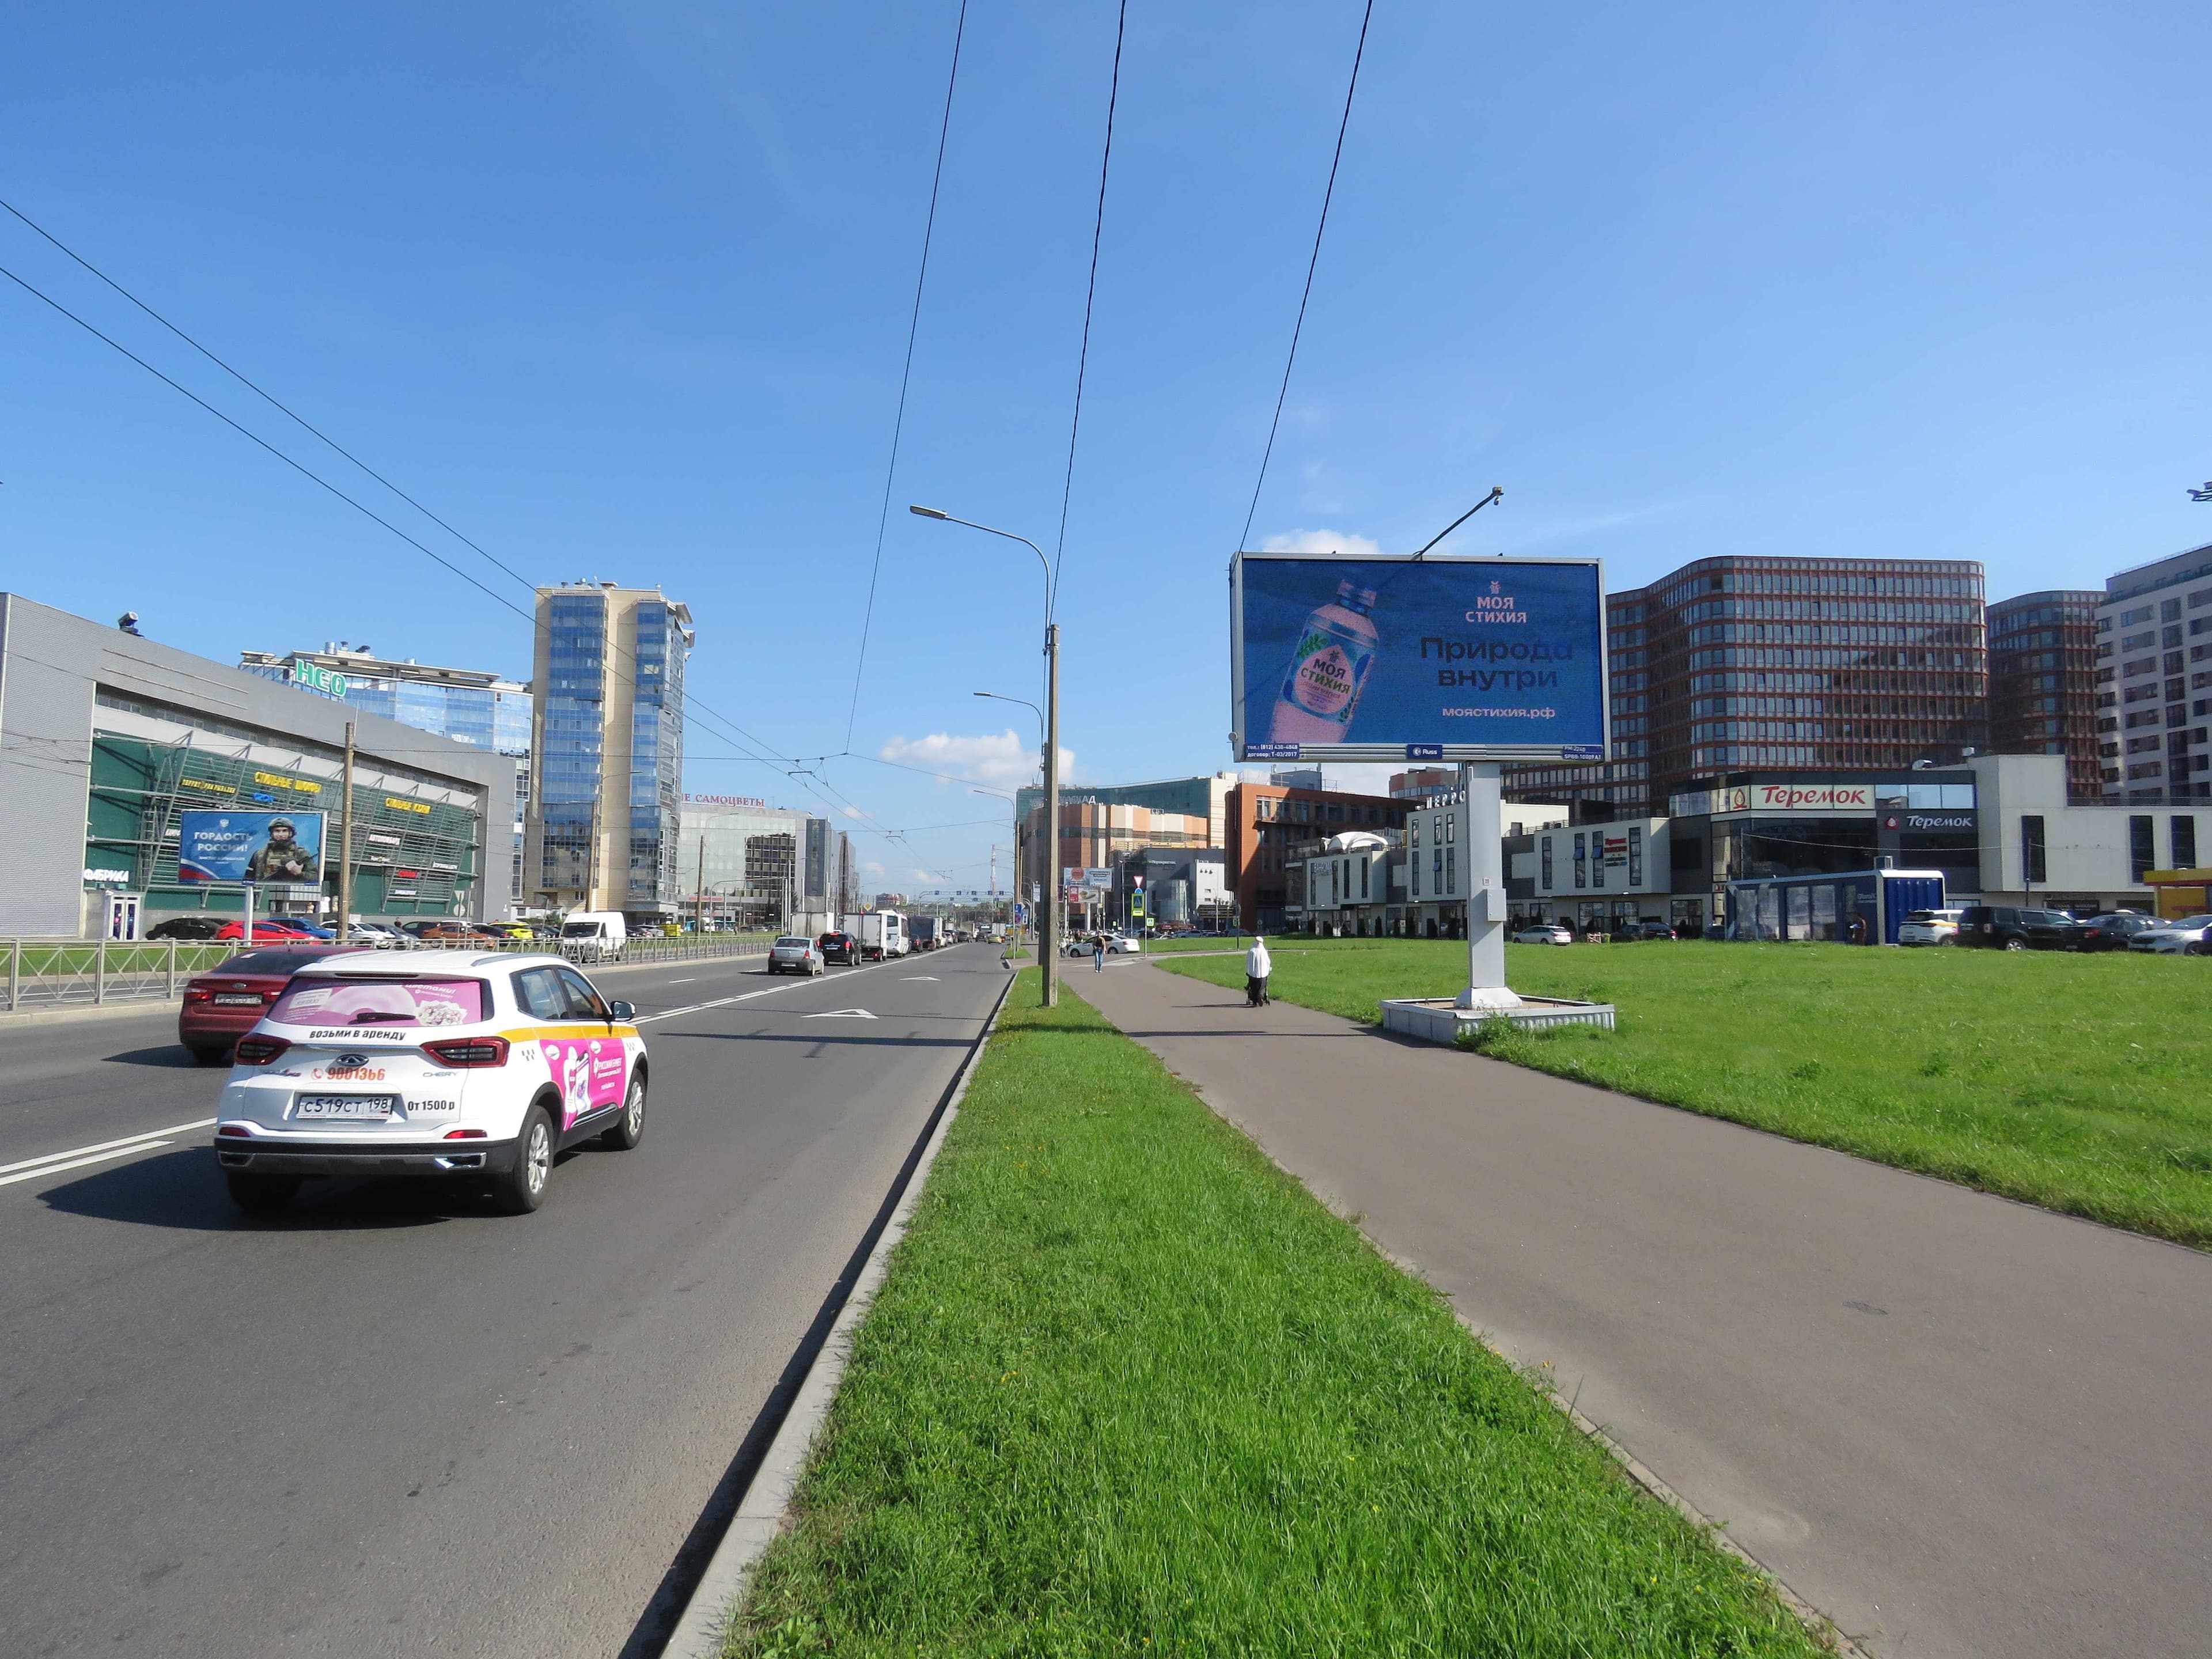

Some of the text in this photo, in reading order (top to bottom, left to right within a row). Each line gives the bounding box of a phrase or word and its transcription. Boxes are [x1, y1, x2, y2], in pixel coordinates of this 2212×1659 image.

[1476, 596, 1514, 609] МОЯ
[1465, 611, 1527, 623] СТИХИЯ
[1421, 637, 1573, 663] Природа
[1313, 658, 1346, 680] МОЯ
[1300, 667, 1351, 695] СТИХИЯ
[1438, 669, 1558, 691] внутри
[1442, 707, 1556, 719] моястихия.рф
[681, 793, 765, 807] Е САМОЦВЕТЫ
[1760, 785, 1866, 808] Теремок
[1907, 815, 1972, 829] Теремок
[194, 831, 253, 842] ГОРДОСТЬ
[198, 843, 248, 852] РОССИИ!
[83, 868, 130, 883] ФАБРИКА
[309, 1030, 351, 1039] возьми
[362, 1031, 406, 1041] аренду
[366, 1097, 388, 1110] 198
[422, 1100, 447, 1111] 1500
